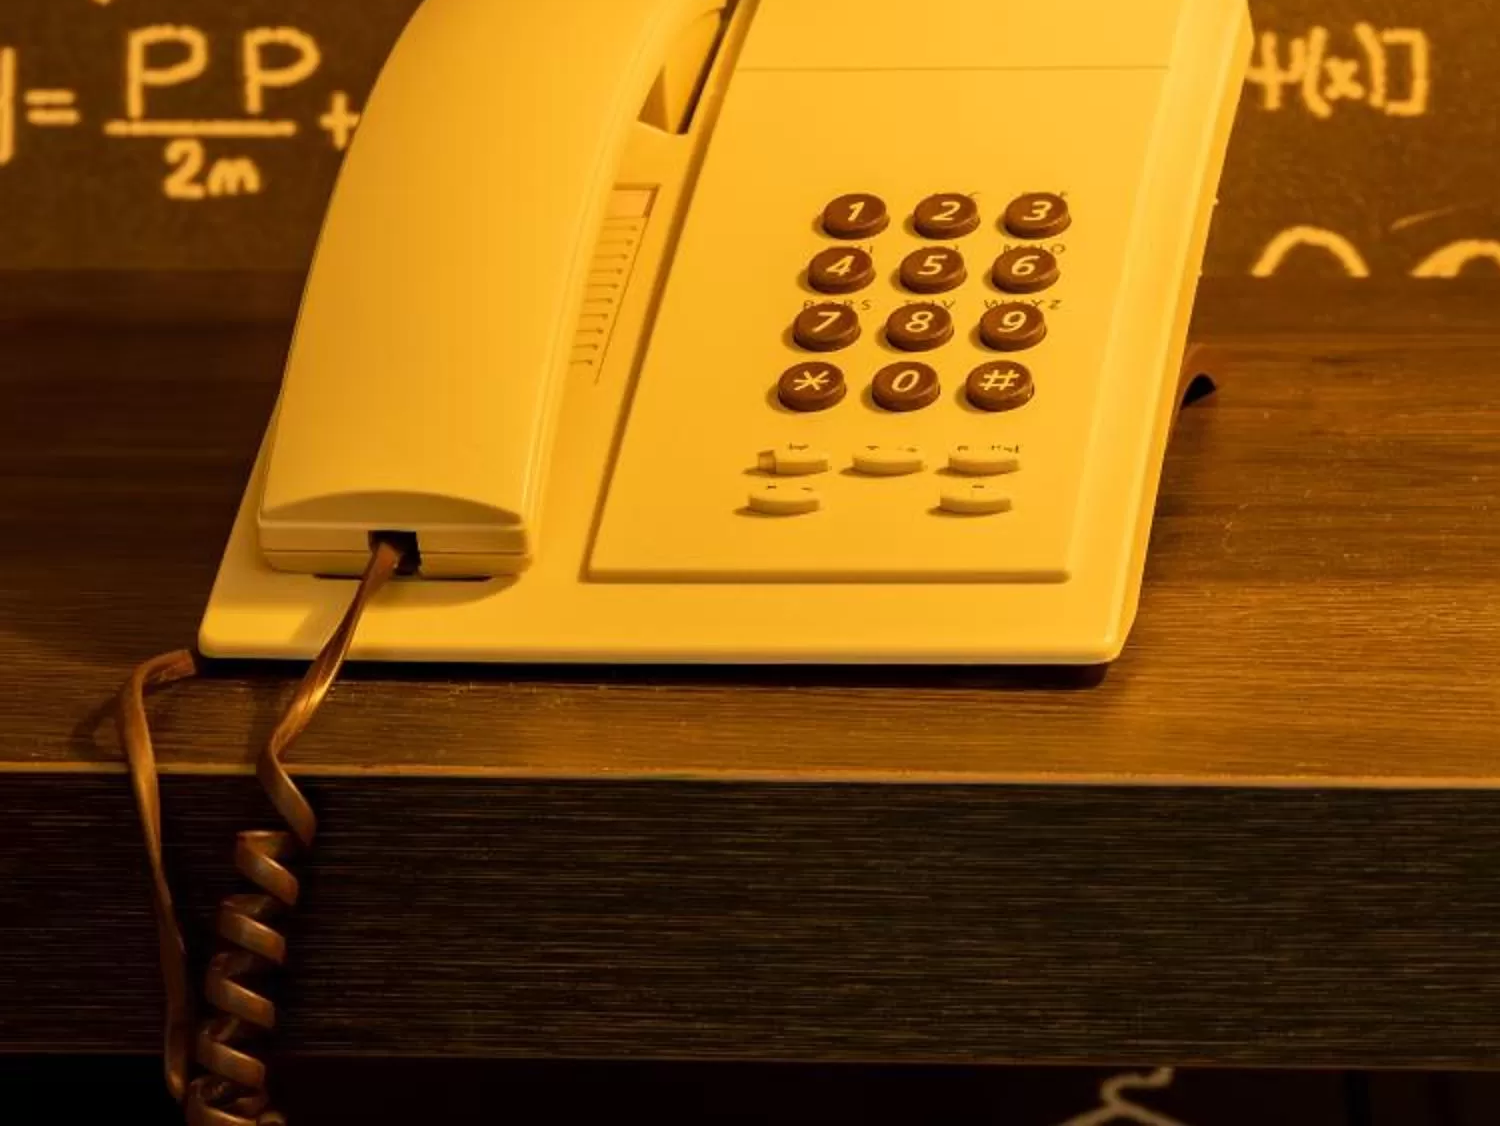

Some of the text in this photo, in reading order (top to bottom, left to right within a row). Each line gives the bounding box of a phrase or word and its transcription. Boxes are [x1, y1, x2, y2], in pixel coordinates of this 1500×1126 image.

[848, 200, 1053, 222] 1 2 3
[826, 254, 1040, 277] 4 5 6
[813, 310, 1027, 333] 7 8 9
[891, 369, 919, 392] 0
